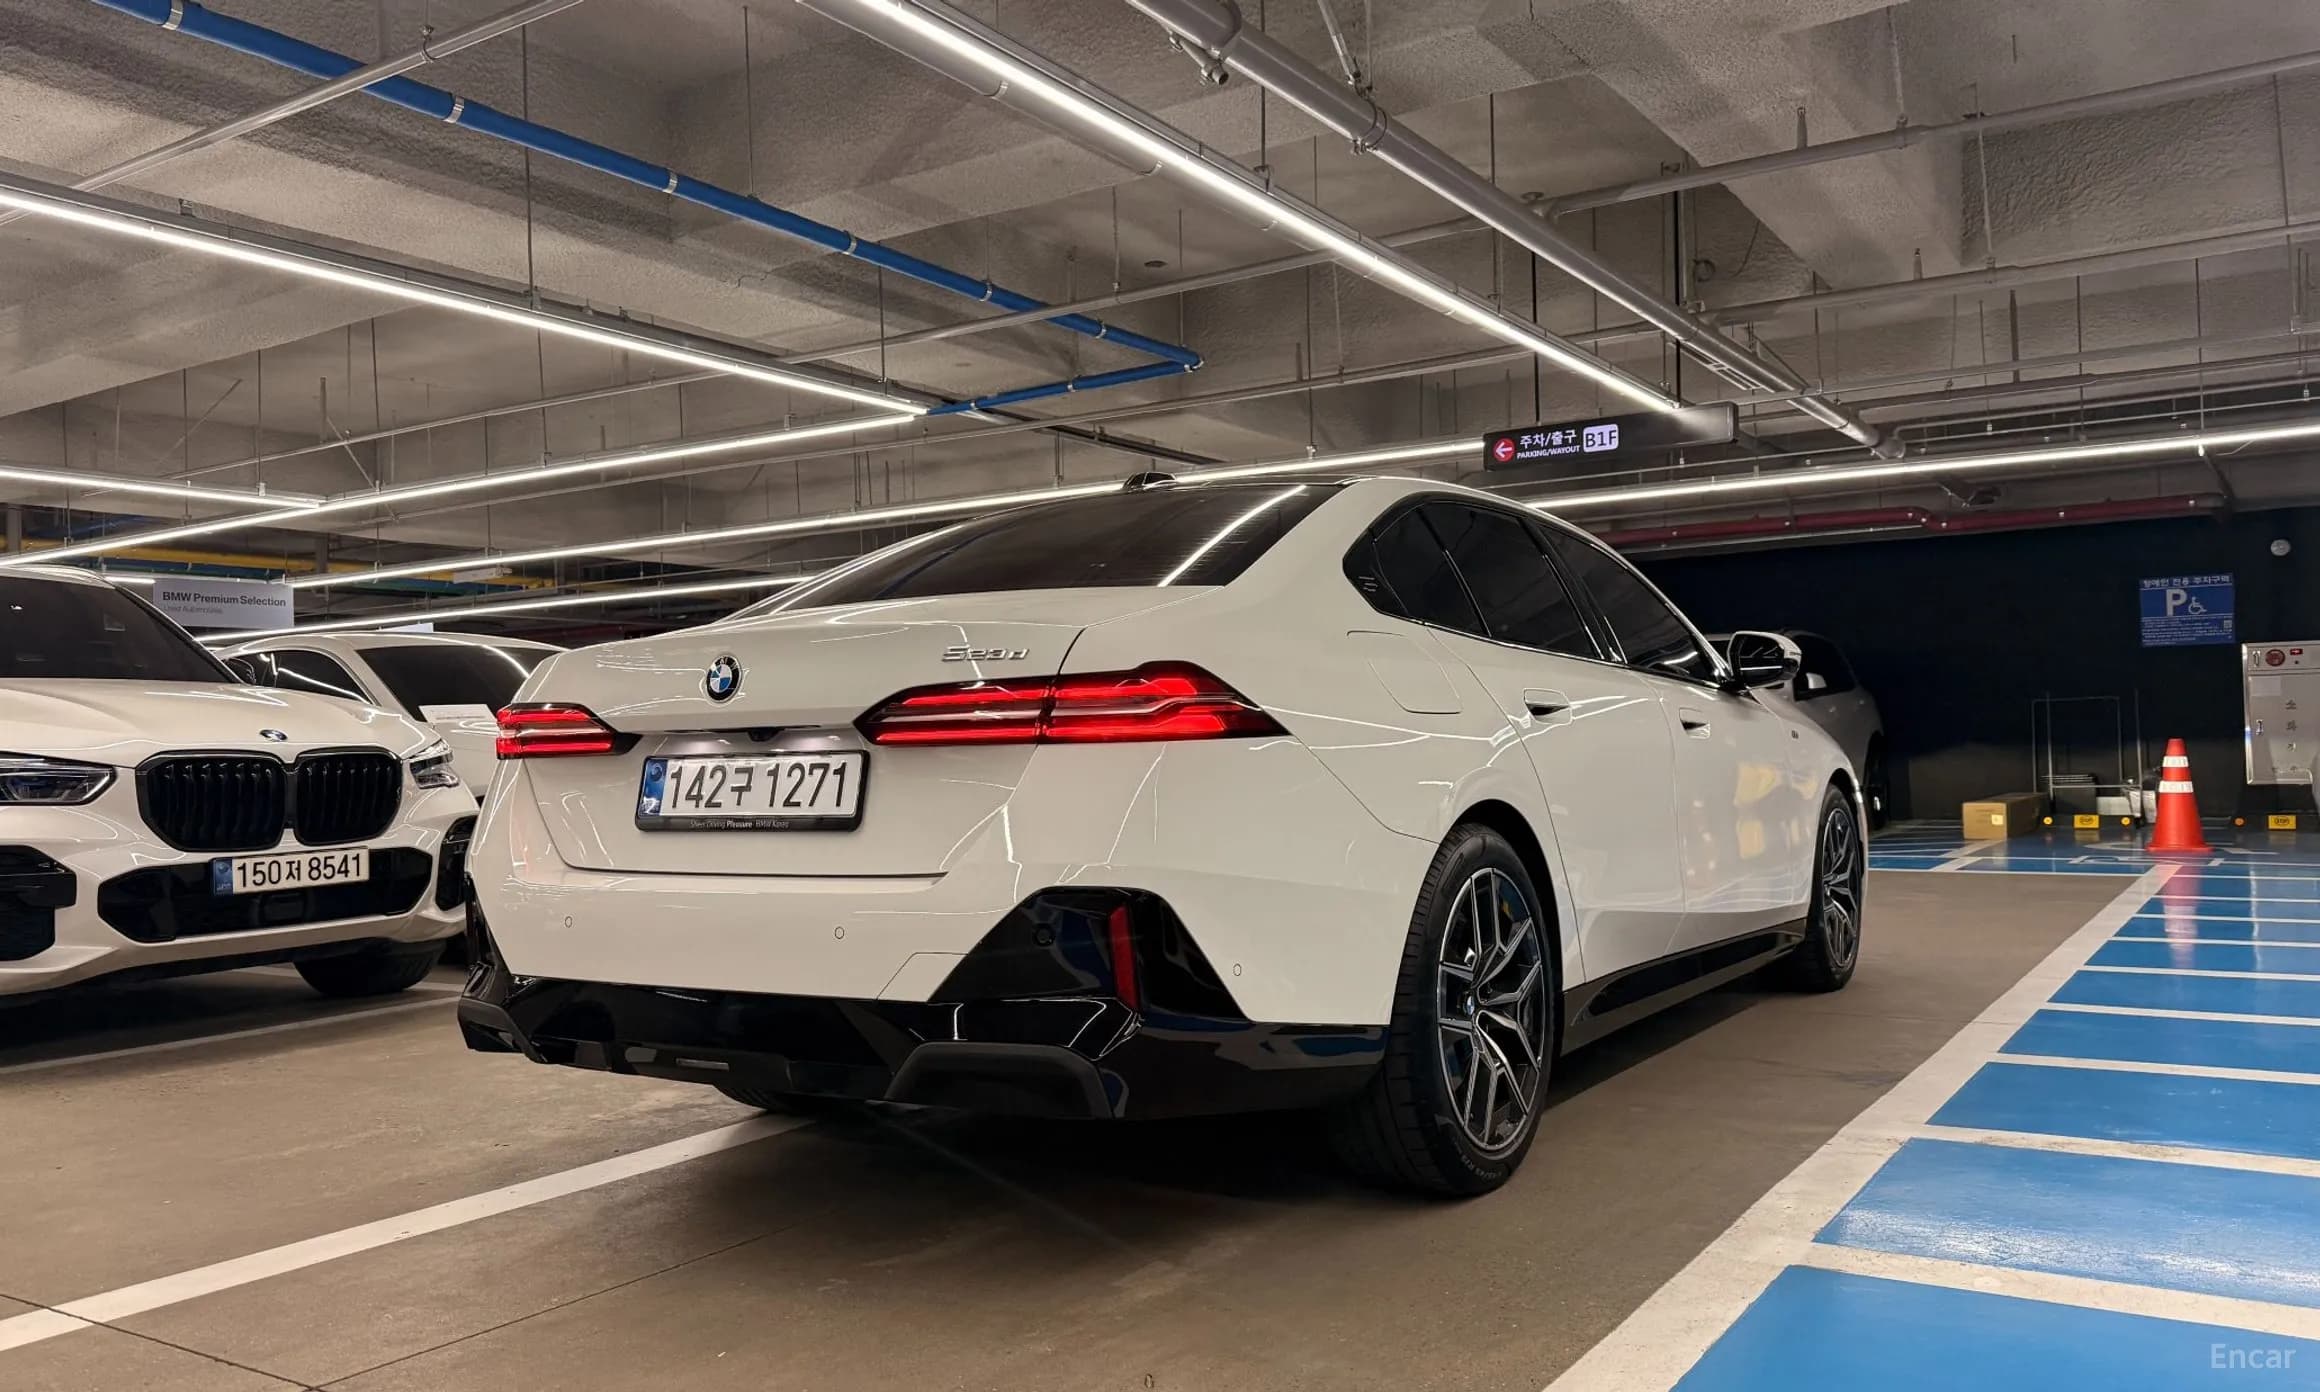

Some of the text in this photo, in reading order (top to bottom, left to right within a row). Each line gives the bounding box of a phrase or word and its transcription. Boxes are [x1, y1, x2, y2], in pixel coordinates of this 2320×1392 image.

[1520, 428, 1577, 449] 주차/출구
[1585, 430, 1617, 448] B1F
[1516, 445, 1581, 460] PARKING/WAYOUT
[162, 591, 287, 607] BMW Premium Selection
[2166, 588, 2188, 617] P
[670, 763, 754, 809] 142구
[766, 761, 848, 808] 1271
[726, 819, 753, 829] Pleasure
[237, 852, 361, 888] 150저 8541
